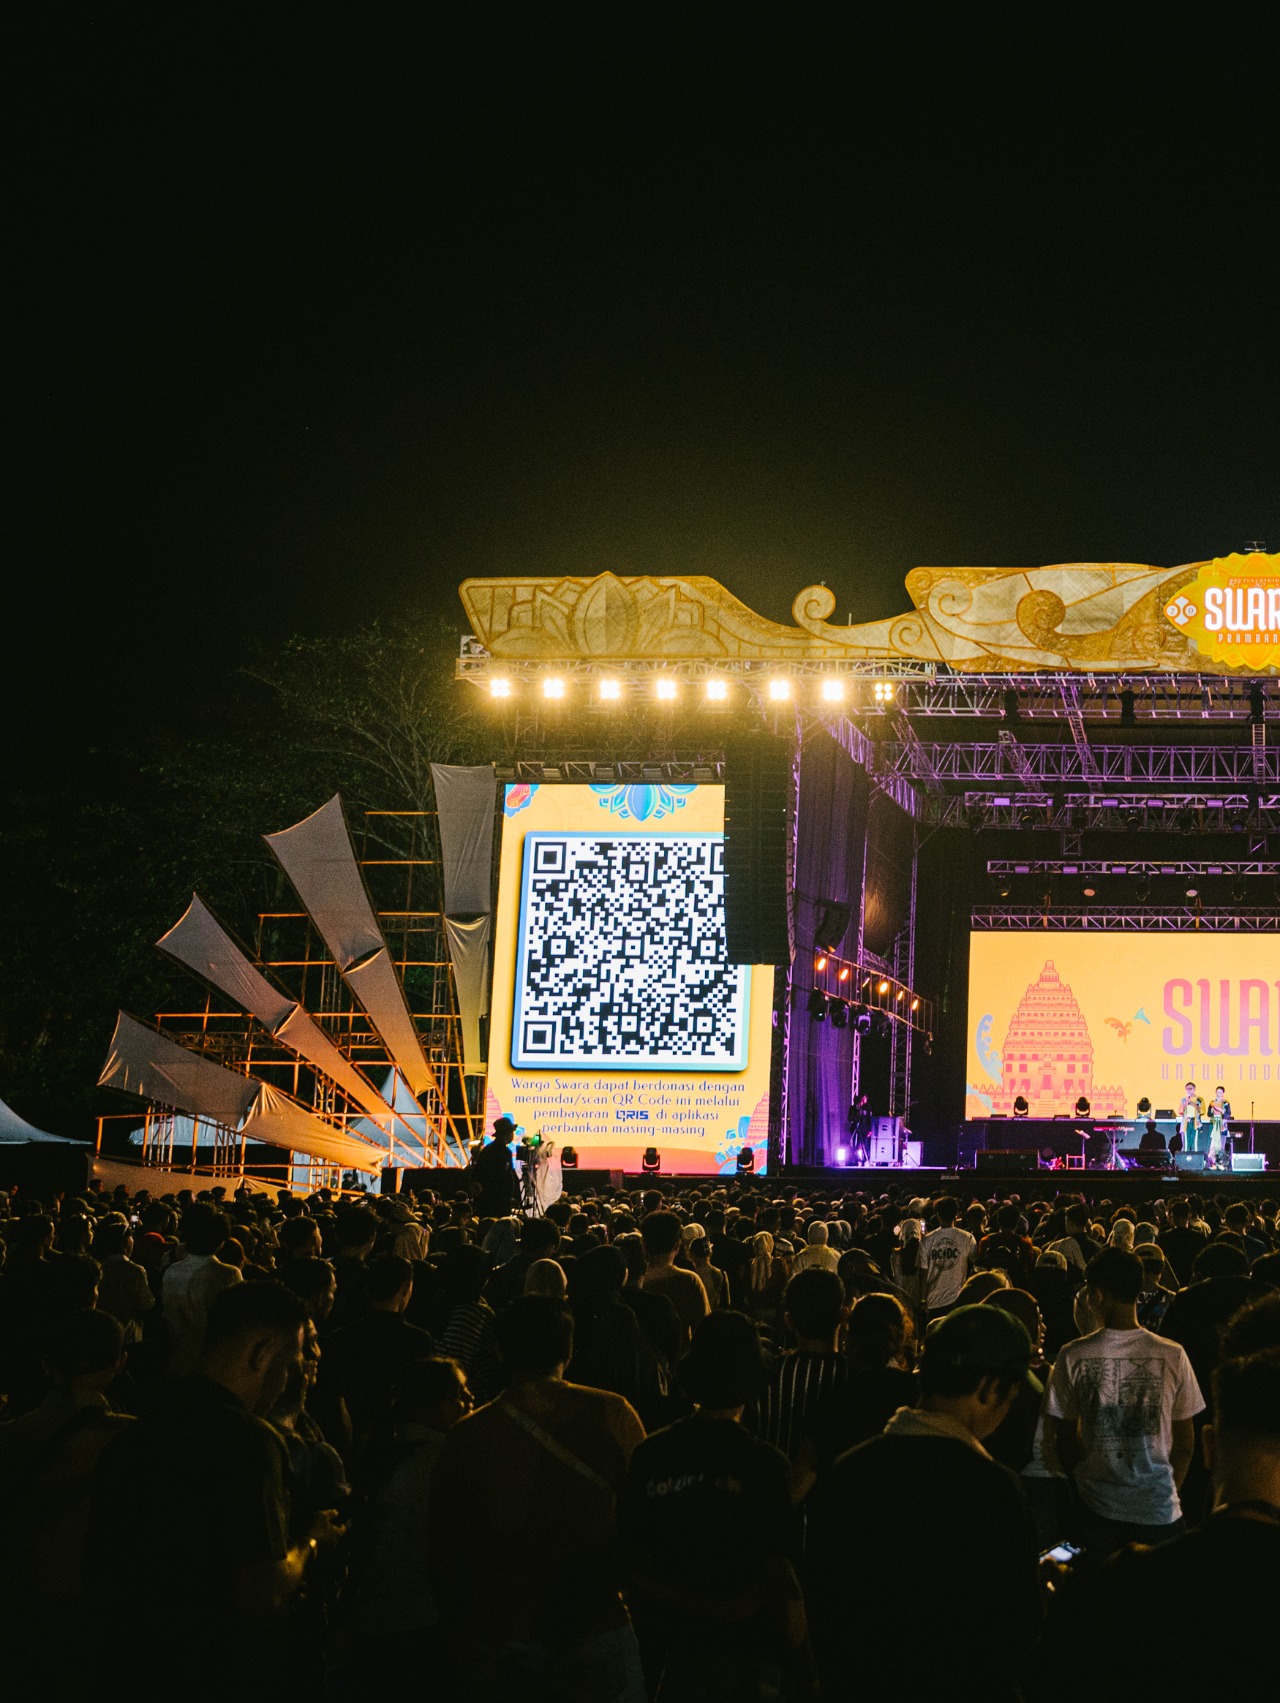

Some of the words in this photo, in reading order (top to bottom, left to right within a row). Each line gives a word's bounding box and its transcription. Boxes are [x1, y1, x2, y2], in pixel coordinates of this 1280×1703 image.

[1161, 1063, 1224, 1080] UNTUK
[511, 1078, 550, 1091] Warga
[555, 1079, 589, 1090] Swara
[594, 1079, 629, 1092] dapat
[634, 1080, 695, 1091] berdonasi
[699, 1080, 744, 1094] dengan
[515, 1093, 608, 1105] memindai/scan
[612, 1094, 633, 1107] QR
[638, 1094, 672, 1106] Code
[676, 1095, 691, 1106] ini
[695, 1095, 740, 1106] melalui
[533, 1108, 608, 1120] pembayaran
[656, 1109, 668, 1120] di
[672, 1109, 719, 1121] aplikasi
[542, 1122, 607, 1134] perbankan
[612, 1123, 709, 1136] masing-masing.
